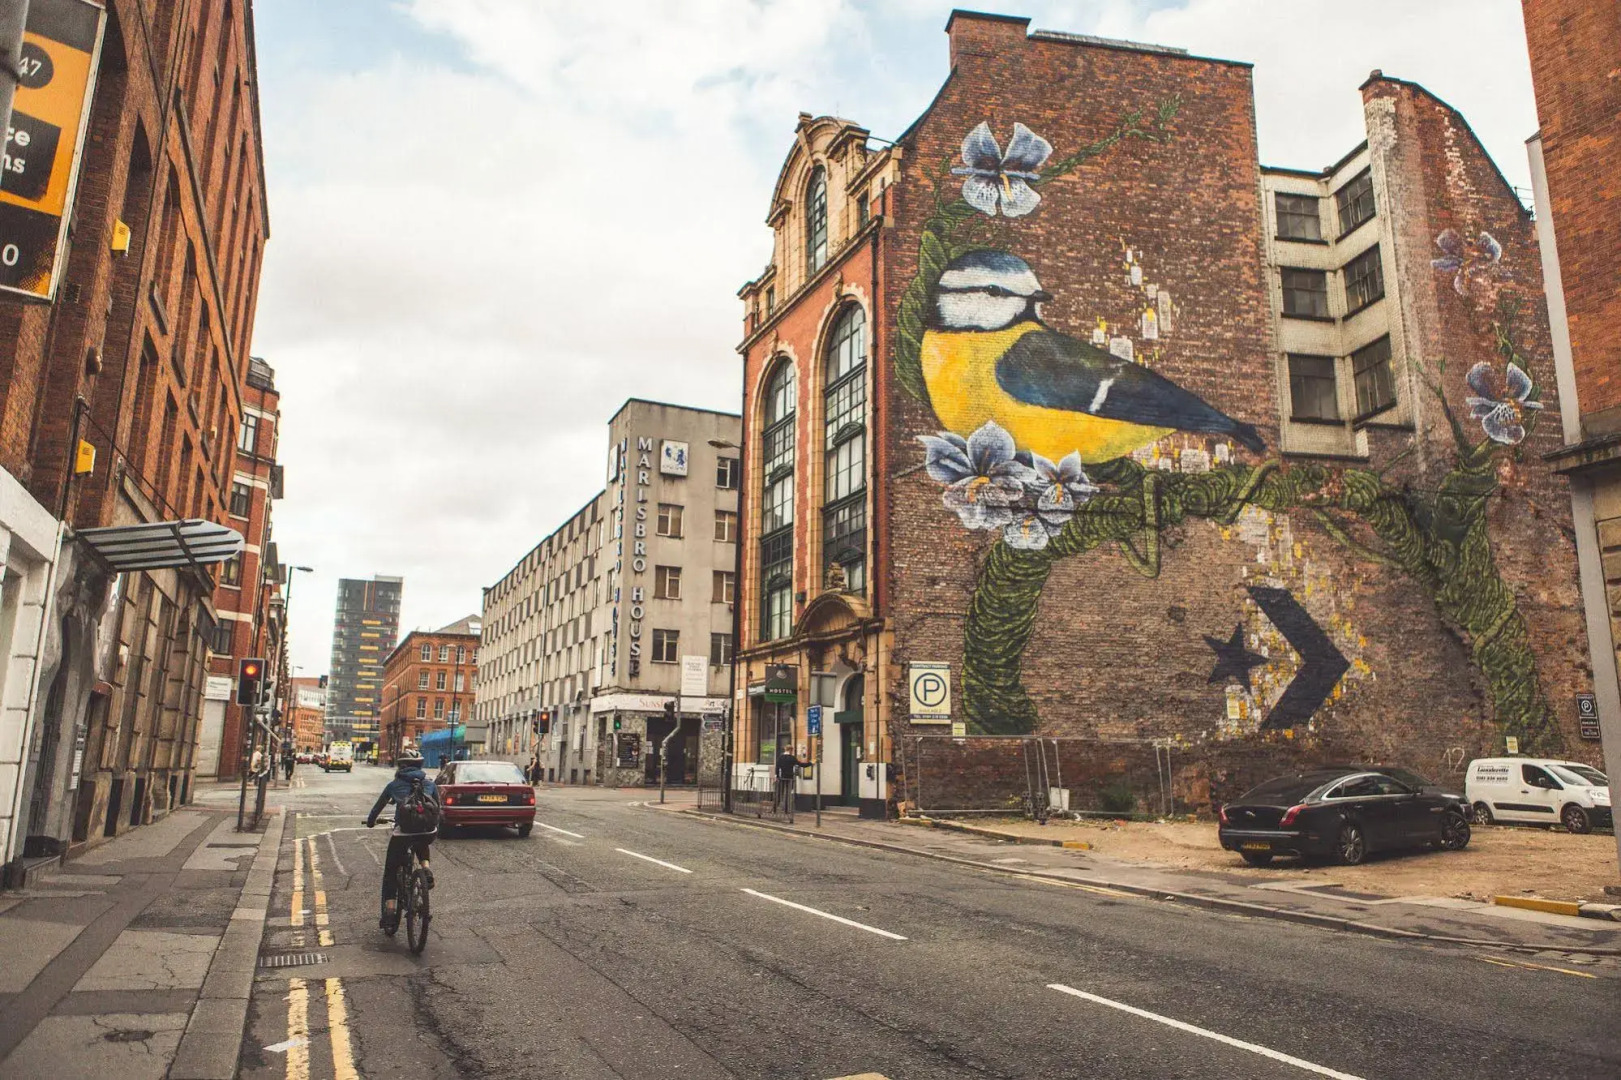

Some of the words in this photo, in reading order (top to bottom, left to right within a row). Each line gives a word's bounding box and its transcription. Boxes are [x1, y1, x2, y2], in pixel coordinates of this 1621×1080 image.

[632, 436, 653, 574] MARLSBRO
[628, 586, 646, 680] HOUSE
[923, 678, 940, 701] P
[1442, 746, 1466, 774] 12
